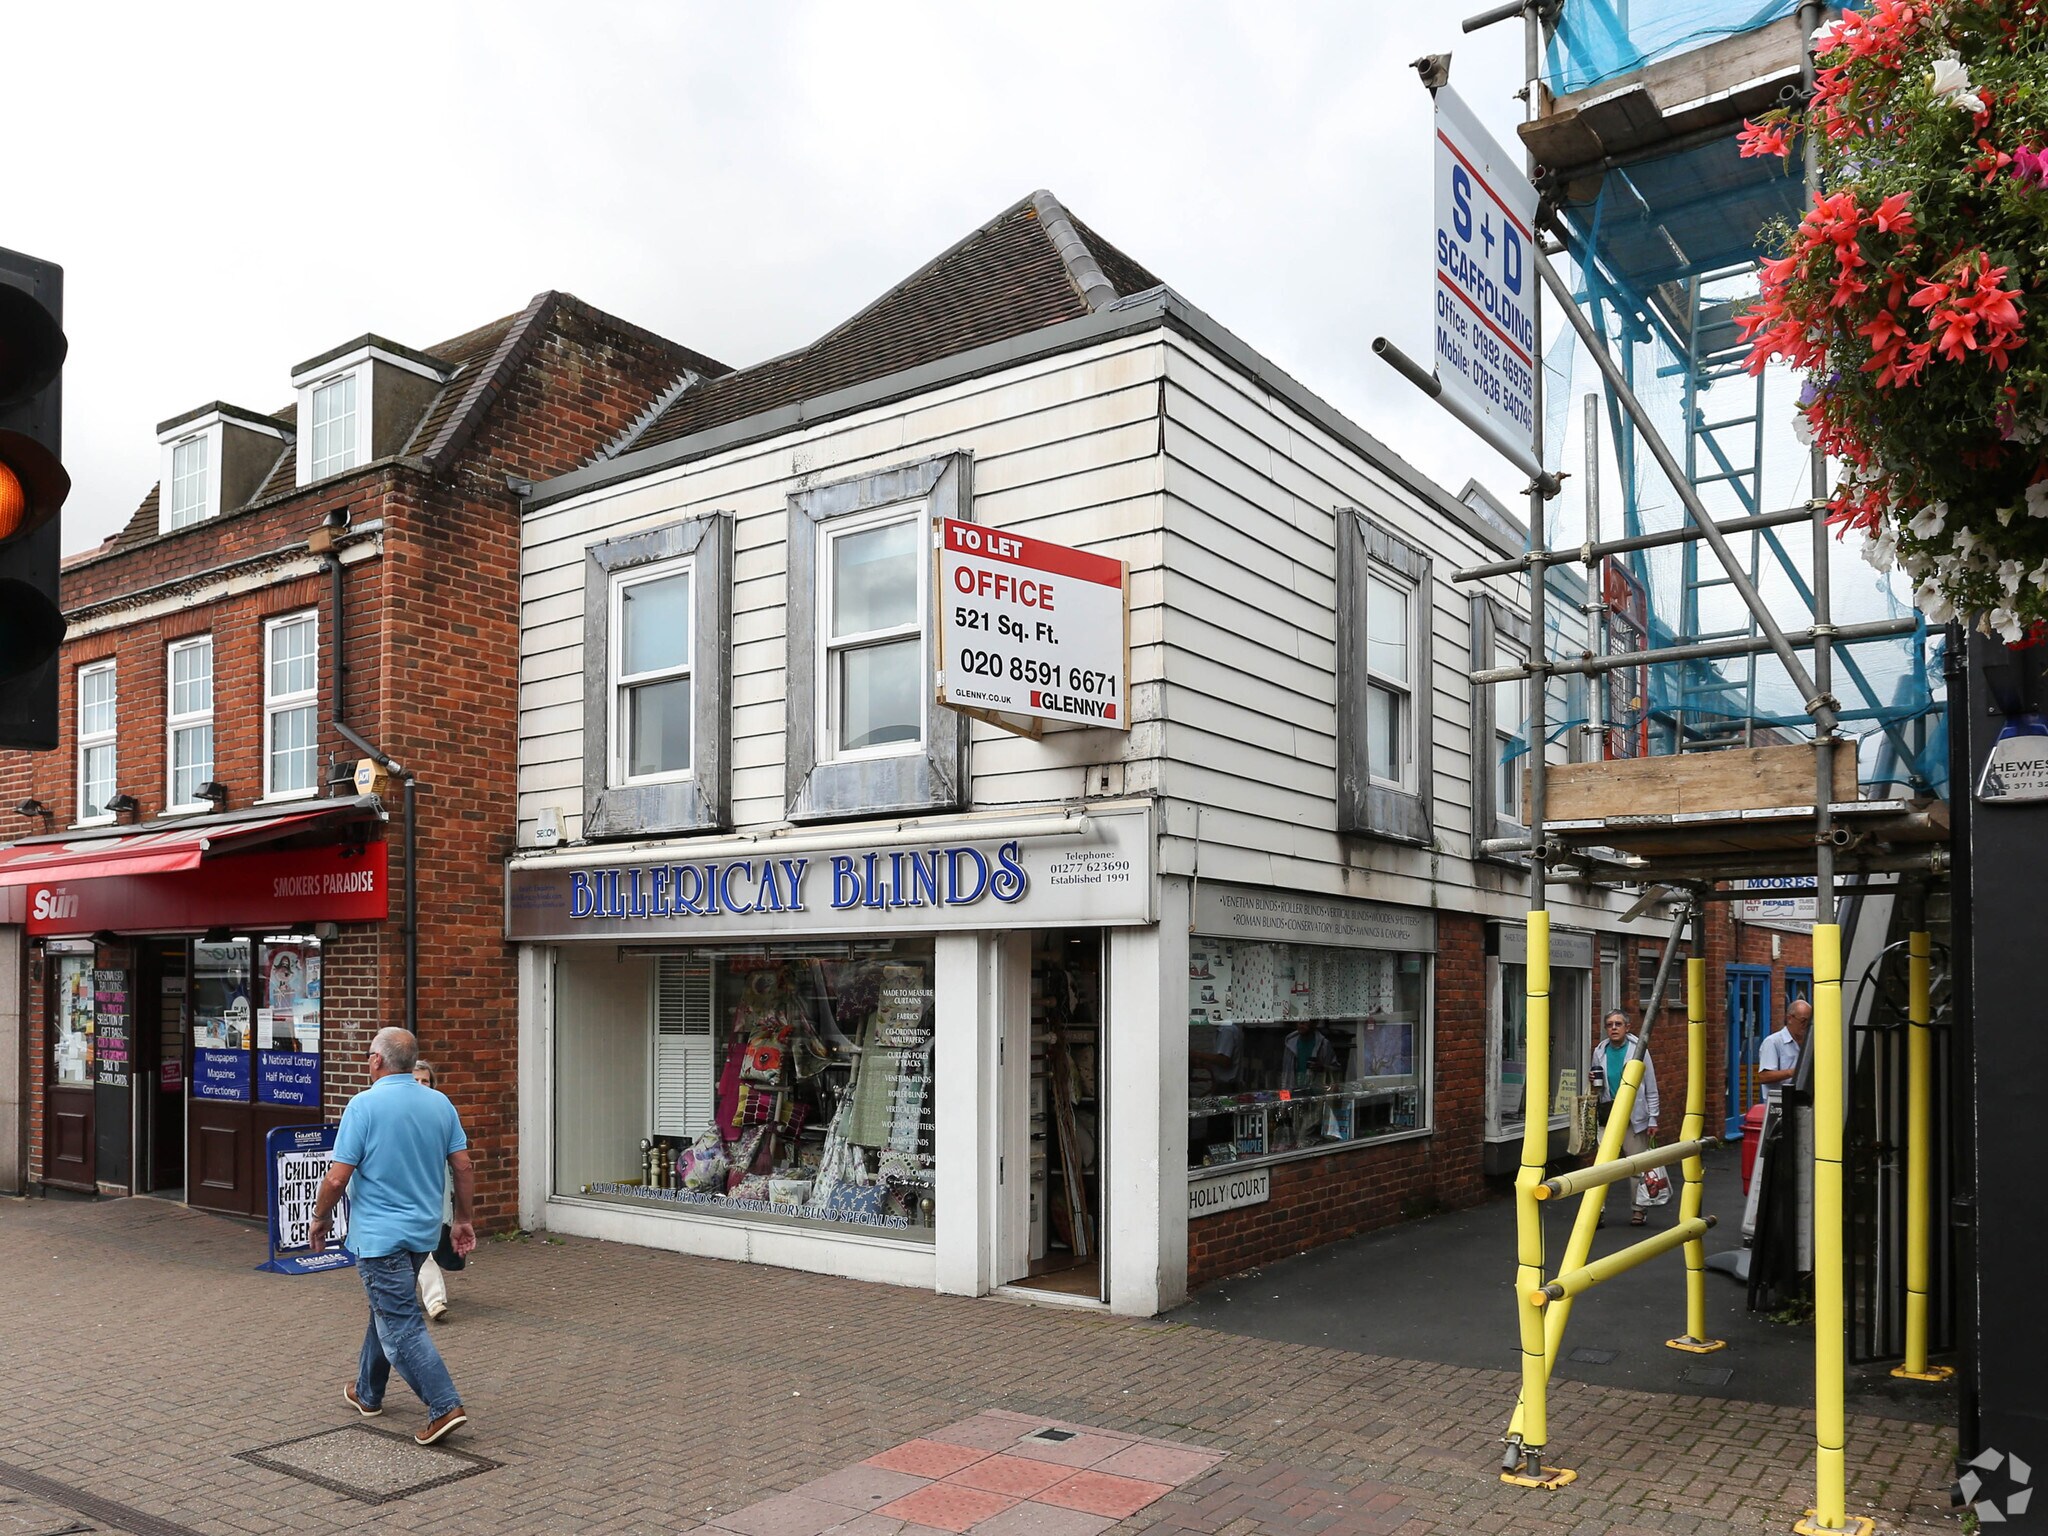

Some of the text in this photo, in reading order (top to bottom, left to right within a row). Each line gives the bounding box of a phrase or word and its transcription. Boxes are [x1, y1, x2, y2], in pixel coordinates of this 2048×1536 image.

[1453, 164, 1472, 243] S
[1504, 219, 1522, 296] D
[1438, 229, 1532, 352] SCAFFOLDING
[1438, 290, 1468, 340] Office:
[1502, 353, 1532, 400] 469756
[1438, 326, 1469, 377] Mobile:
[1473, 359, 1500, 404] 07836
[952, 526, 1023, 559] TO LET
[954, 565, 1055, 611] OFFICE
[955, 607, 1059, 644] 521 Sq. Ft.
[960, 648, 1116, 697] 020 8591 6671
[955, 688, 1012, 704] GLENNY.CO.UK
[1041, 692, 1106, 718] GLENNY
[536, 829, 556, 838] SECOM
[1065, 851, 1115, 861] Telephone:
[1050, 861, 1130, 873] 01277 623690
[273, 870, 374, 898] SMOKERS PARADISE
[569, 840, 1028, 919] BILLERICAY BLINDS
[1051, 873, 1129, 885] Established 1991
[1747, 877, 1815, 889] MOORES
[56, 887, 66, 896] THE
[33, 889, 79, 920] Sun
[1222, 896, 1254, 909] VENETIAN
[1255, 898, 1278, 912] BLINDS
[1280, 901, 1302, 914] ROLLER
[1303, 904, 1324, 917] BLINDS
[1327, 907, 1350, 920] VERTICAL
[1351, 909, 1369, 921] BLINDS
[1371, 911, 1394, 923] WOODEN
[1235, 914, 1261, 927] ROMAN
[1262, 917, 1285, 930] BLINDS
[1287, 920, 1333, 933] CONSERVATORY
[1334, 924, 1354, 936] BLINDS
[883, 989, 933, 997] MADE TO MEASURE
[101, 1027, 111, 1038] GIFT
[885, 1028, 931, 1036] CO-ORDINATING
[891, 1036, 925, 1044] WALLPAPERS
[204, 1052, 238, 1064] Newspapers
[268, 1055, 317, 1069] National Lottery
[887, 1051, 928, 1060] CURTAIN POLES
[207, 1068, 236, 1080] Magazines
[265, 1072, 312, 1085] Half Price Cards
[885, 1074, 932, 1083] VENETIAN BLINDS
[273, 1088, 304, 1102] Stationery
[887, 1090, 928, 1099] ROLLER BLINDS
[911, 1106, 931, 1115] BLINDS
[1236, 1113, 1262, 1138] LIFE
[294, 1131, 322, 1140] Gazette
[1236, 1138, 1262, 1154] SIMPLE
[285, 1160, 334, 1181] CHILDR
[911, 1170, 935, 1178] CANOPIE
[285, 1182, 318, 1202] HIT BY
[1189, 1177, 1267, 1209] HOLLY COURT
[288, 1203, 300, 1222] IN
[591, 1182, 909, 1230] MADE TO MEASURE BLINDS CONSERVATORY BLIND SPECIALISTS
